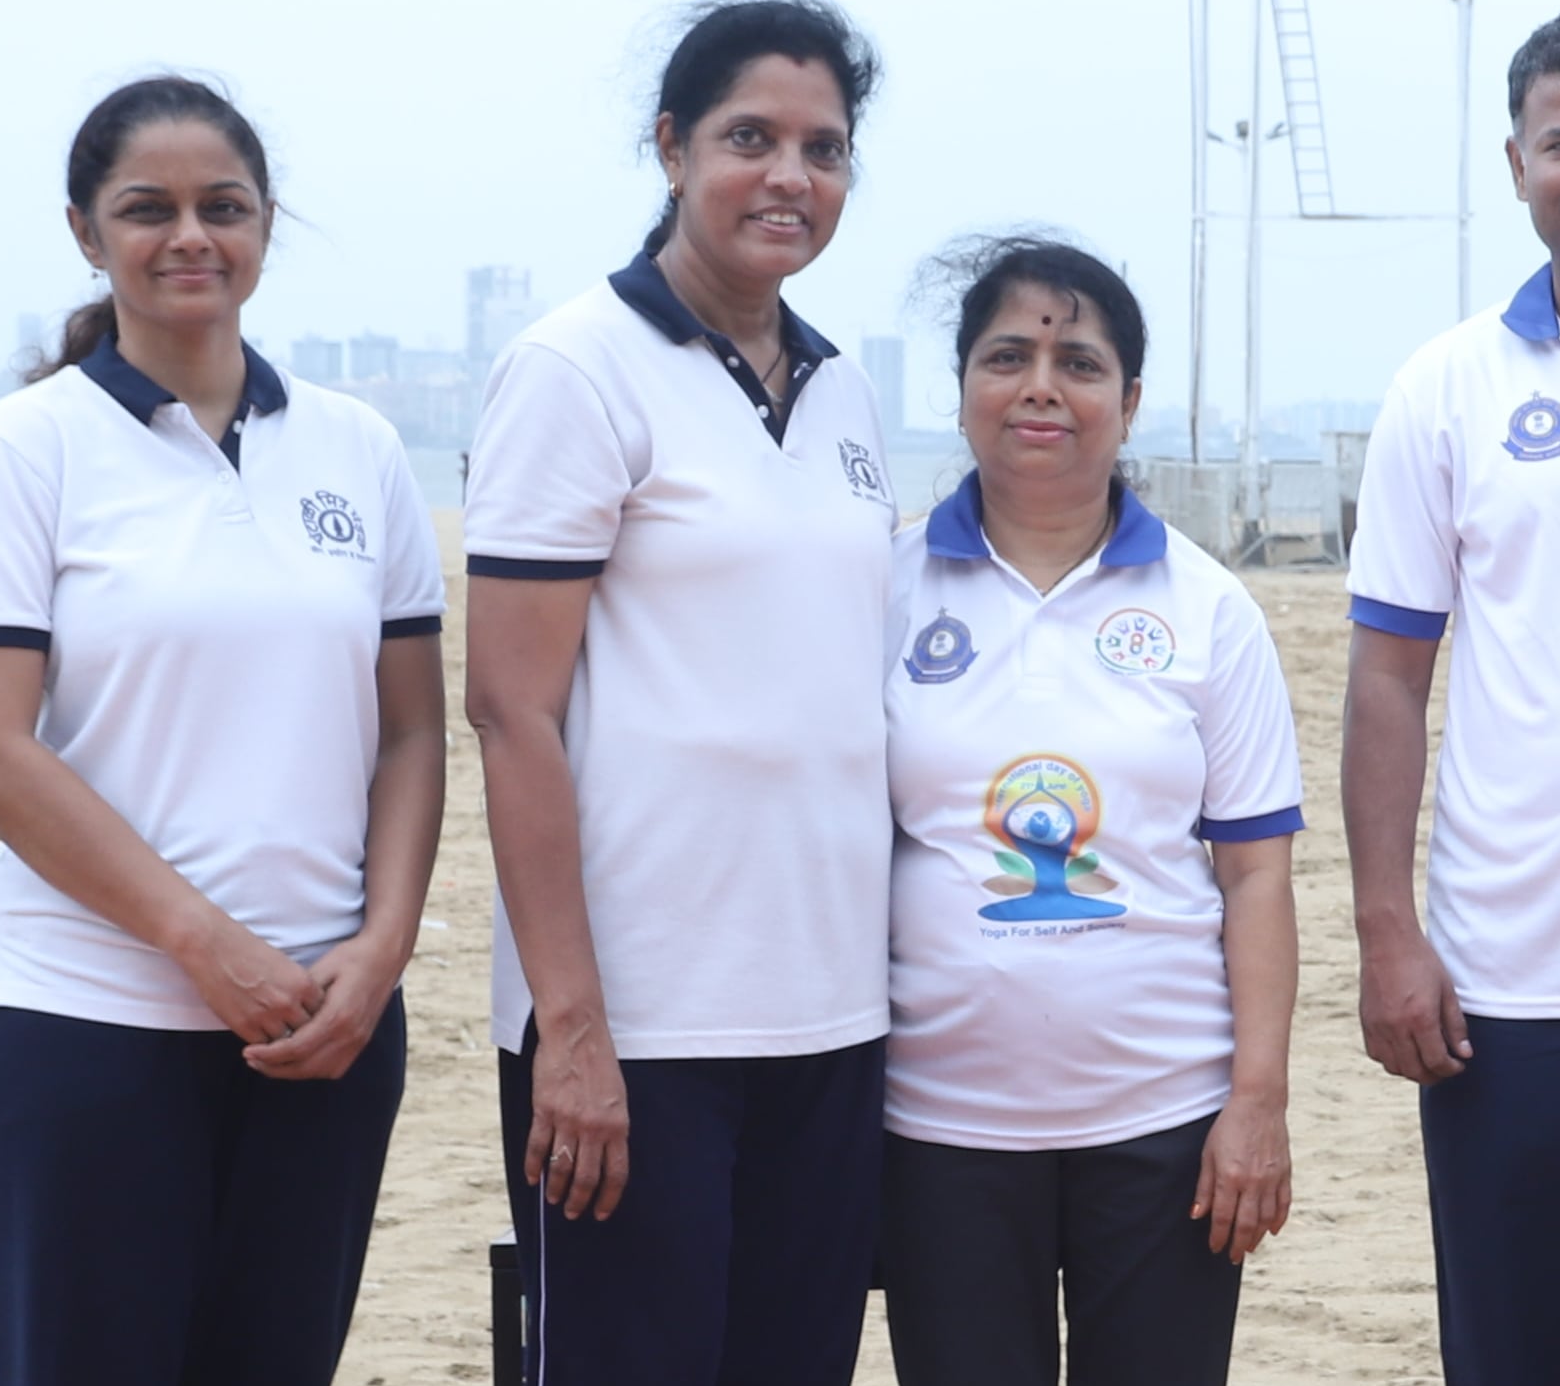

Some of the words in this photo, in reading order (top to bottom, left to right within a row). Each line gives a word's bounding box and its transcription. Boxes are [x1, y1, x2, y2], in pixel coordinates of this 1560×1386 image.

[980, 926, 1007, 939] Yoga
[1011, 926, 1031, 937] For
[1034, 925, 1056, 936] Self
[1059, 923, 1084, 934] And
